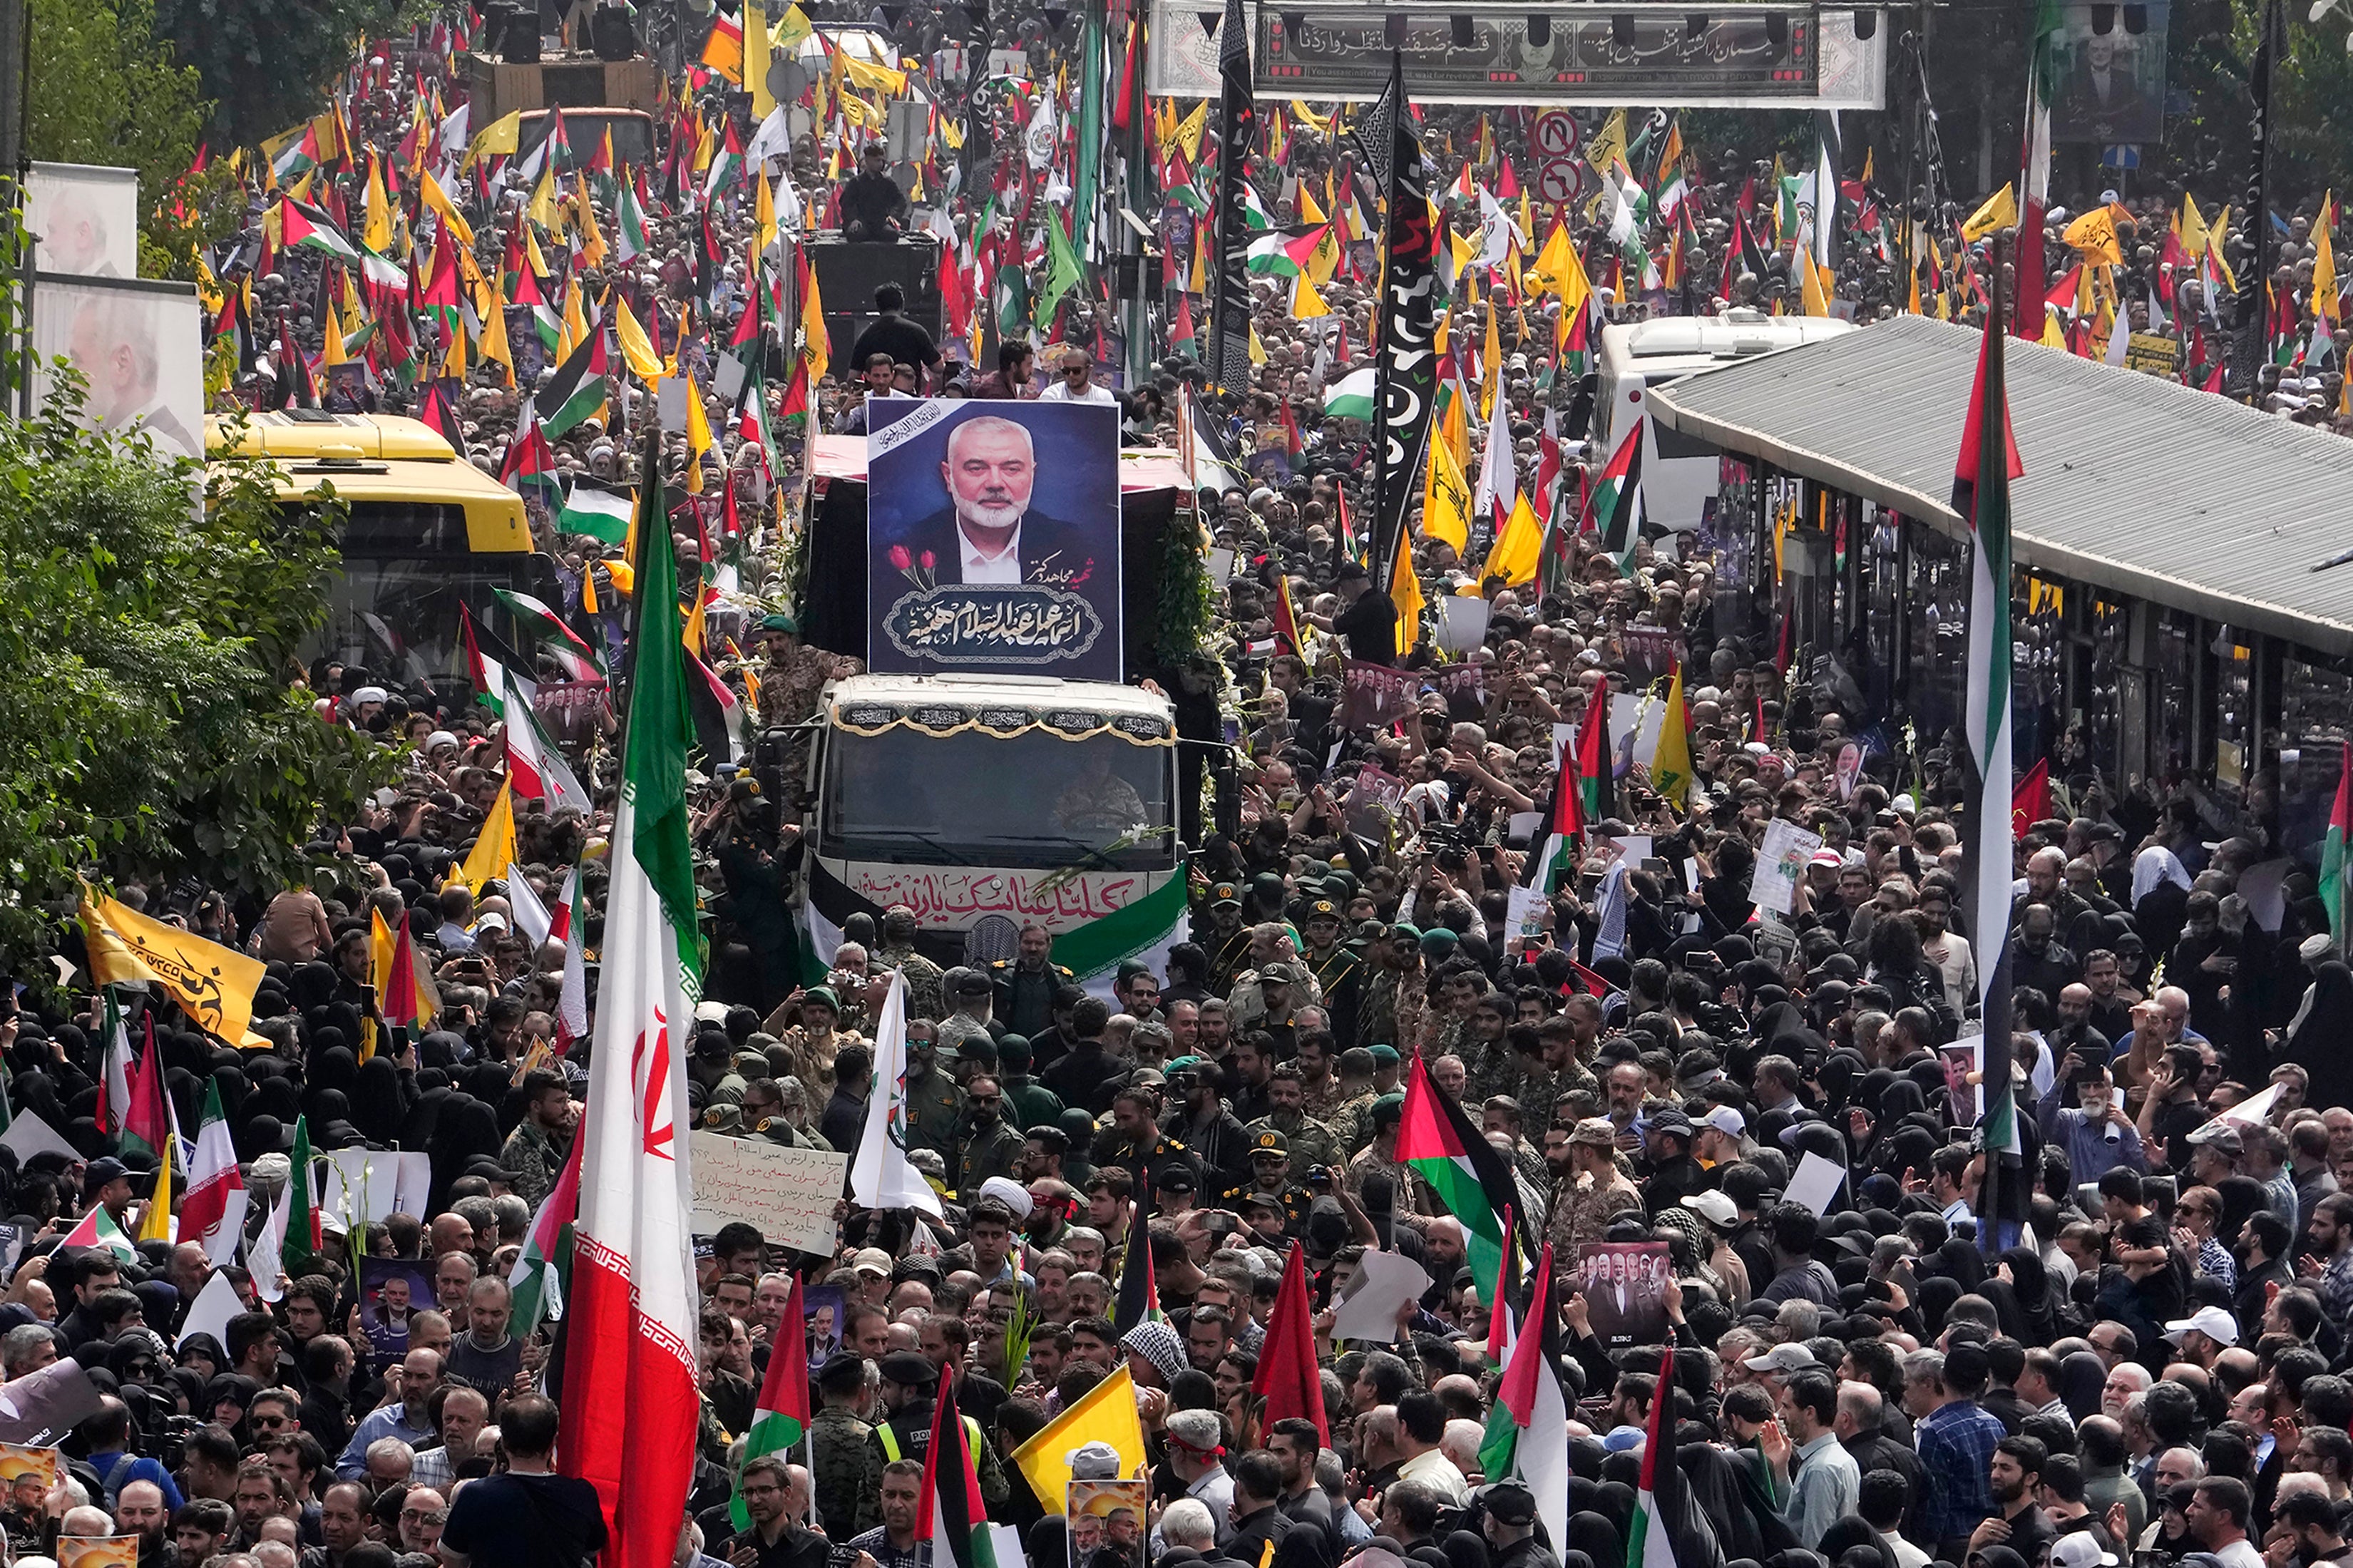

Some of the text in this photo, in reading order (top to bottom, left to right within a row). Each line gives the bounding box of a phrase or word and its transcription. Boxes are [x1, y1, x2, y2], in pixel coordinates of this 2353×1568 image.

[1025, 549, 1094, 590] شهید مجاهد دکتر
[906, 600, 956, 645] هنیه
[1016, 603, 1080, 645] اسماعیل
[784, 1152, 807, 1166] ارتش
[734, 1159, 742, 1174] را
[792, 1170, 816, 1184] سران
[832, 1172, 840, 1185] تا
[713, 1190, 722, 1201] را
[771, 1201, 794, 1212] سران
[779, 1216, 816, 1234] بیاورید
[824, 1221, 830, 1235] ما
